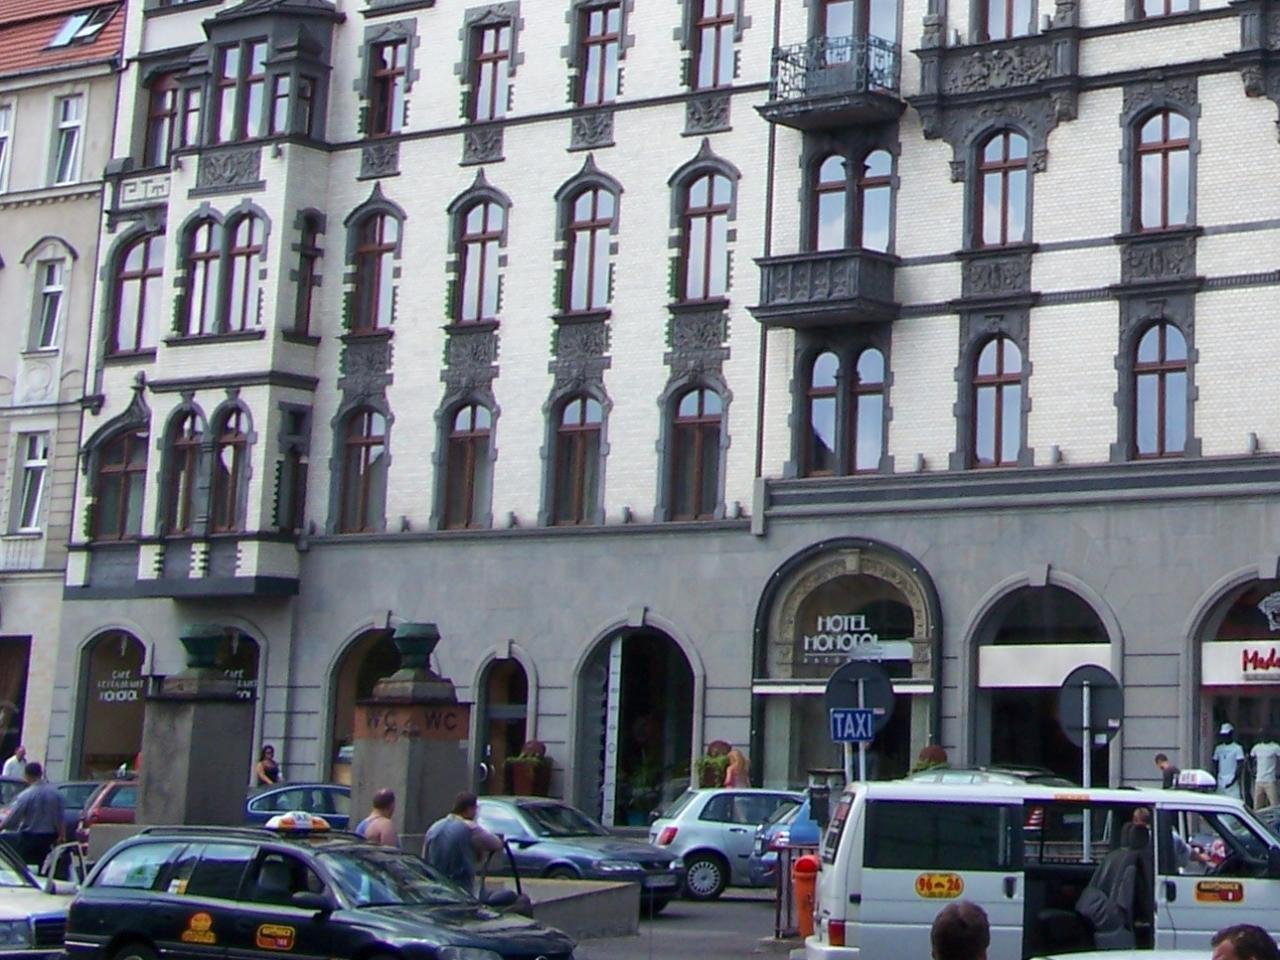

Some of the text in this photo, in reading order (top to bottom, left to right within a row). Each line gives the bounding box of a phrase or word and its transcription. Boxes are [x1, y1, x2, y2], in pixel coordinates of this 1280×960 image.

[817, 614, 871, 632] HOTEL
[804, 633, 879, 651] MONOPOL
[425, 711, 457, 731] WC
[833, 712, 872, 738] TAXI
